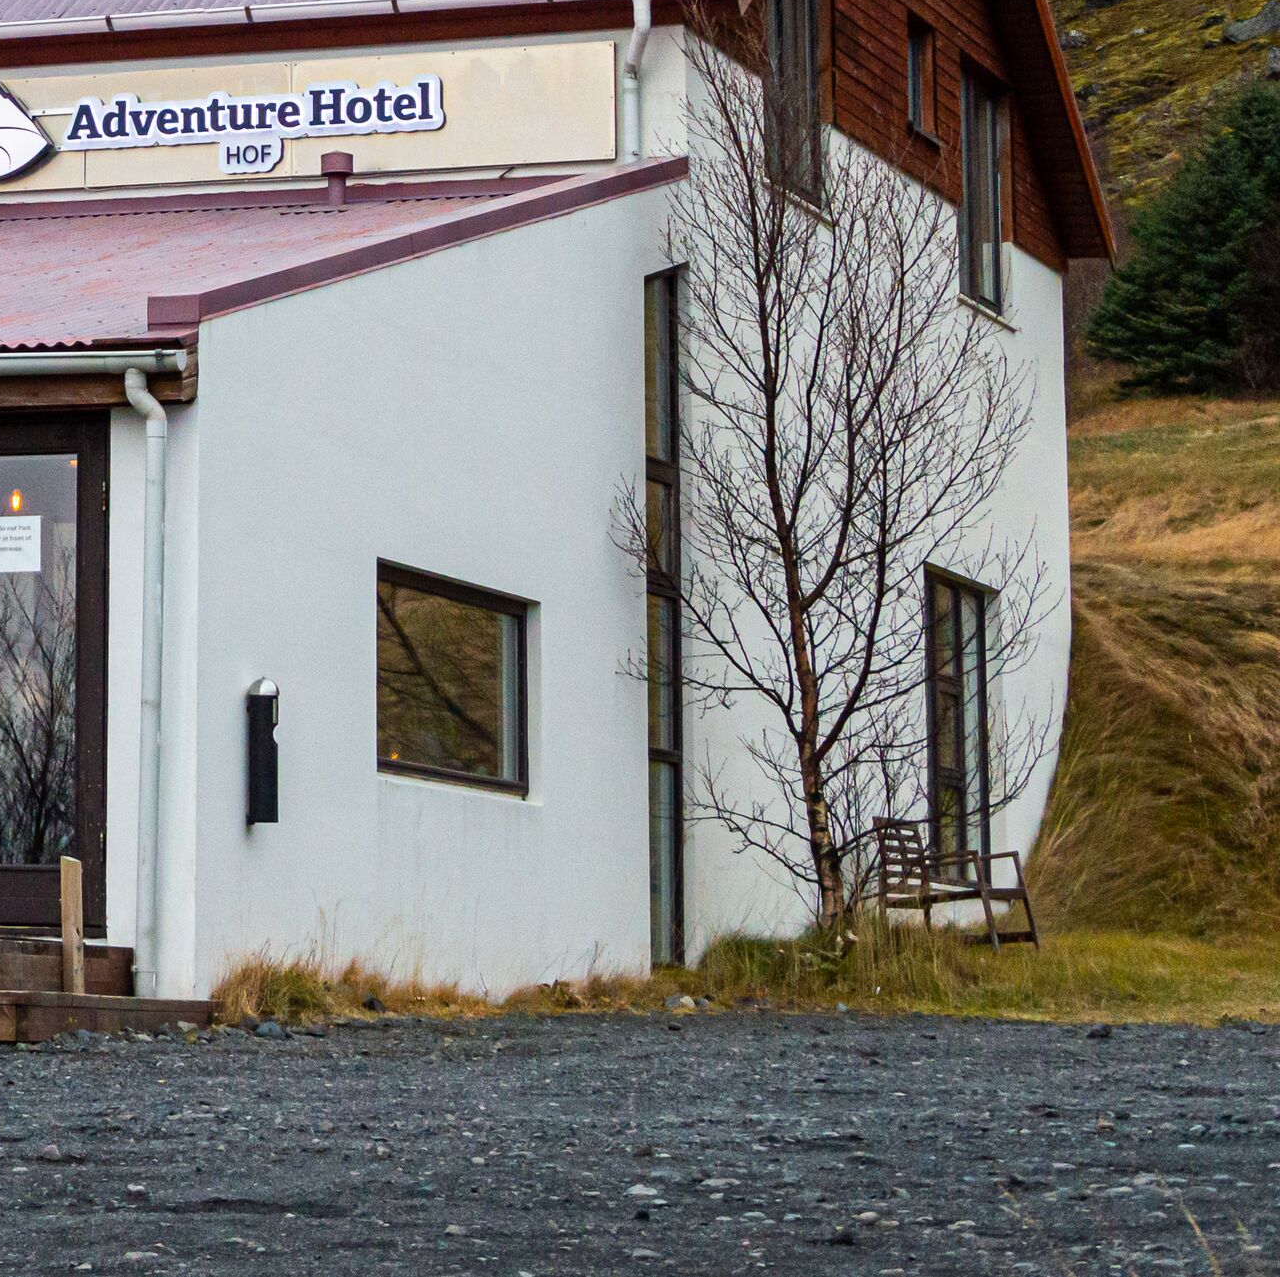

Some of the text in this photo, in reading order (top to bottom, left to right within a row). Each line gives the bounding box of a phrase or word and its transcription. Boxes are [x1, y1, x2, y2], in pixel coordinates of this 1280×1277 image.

[67, 82, 434, 140] Adventure Hotel
[225, 143, 272, 164] HOF
